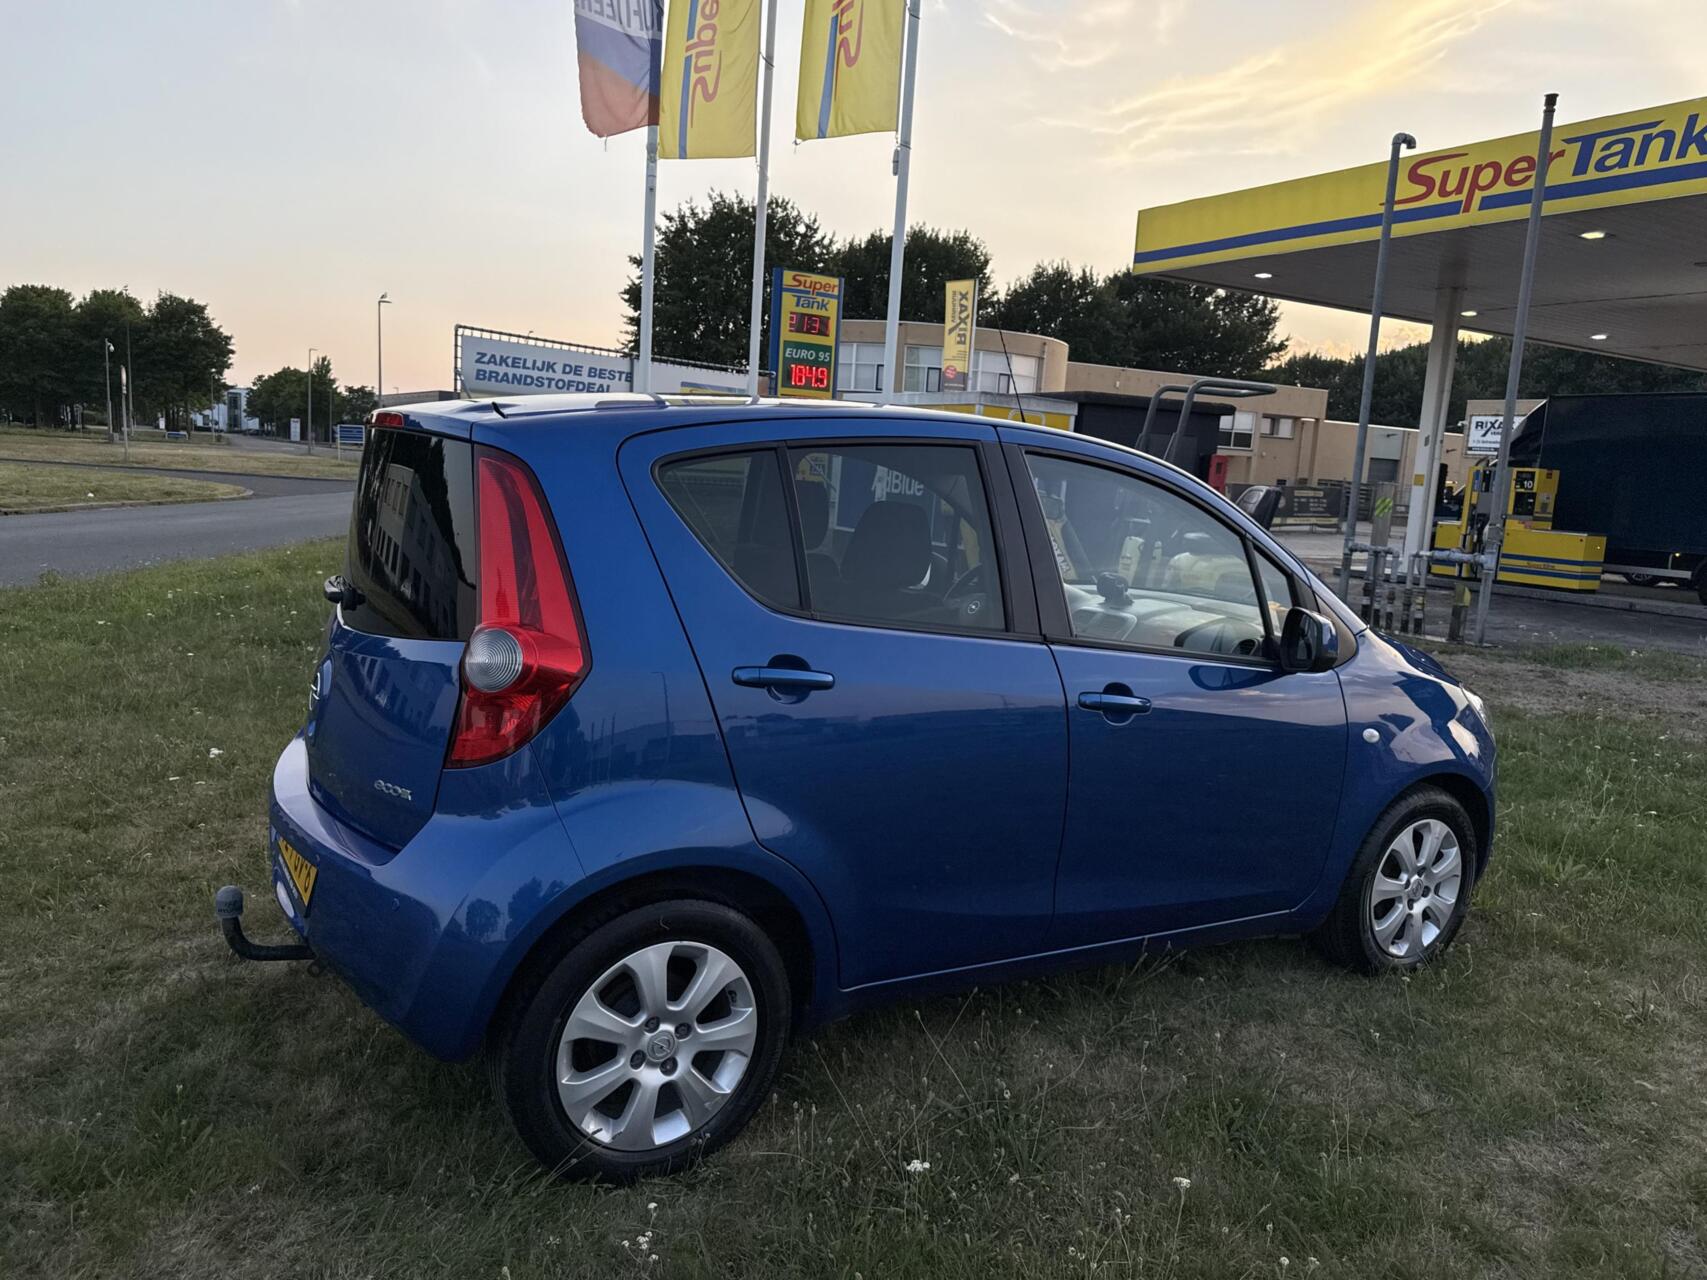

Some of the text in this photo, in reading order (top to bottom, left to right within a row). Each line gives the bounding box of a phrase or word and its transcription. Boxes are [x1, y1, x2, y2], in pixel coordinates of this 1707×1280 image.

[1561, 113, 1707, 176] Tank
[784, 274, 838, 296] Super
[792, 295, 829, 311] Tank
[785, 348, 831, 362] EURO 95
[475, 352, 632, 383] ZAKELIJK DE BESTE
[1523, 480, 1534, 489] 10
